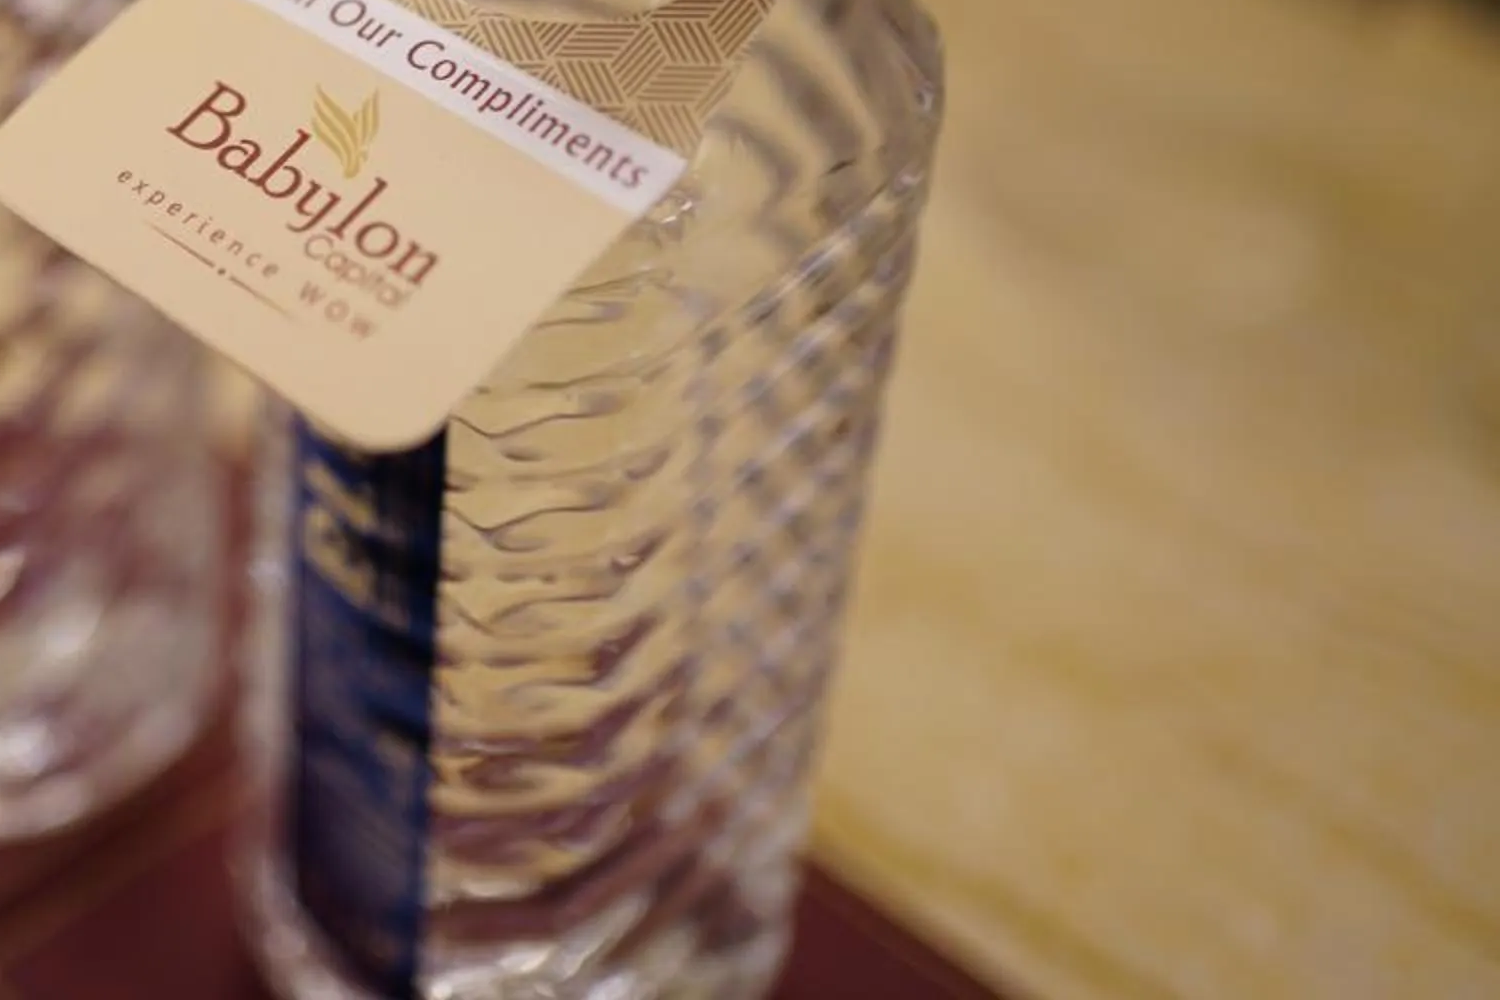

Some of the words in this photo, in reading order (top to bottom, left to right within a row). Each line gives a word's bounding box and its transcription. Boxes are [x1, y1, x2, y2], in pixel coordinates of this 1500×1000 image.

[406, 40, 649, 189] Compliments
[117, 168, 280, 279] experience
[166, 80, 439, 286] Babylon
[304, 233, 414, 310] Capital
